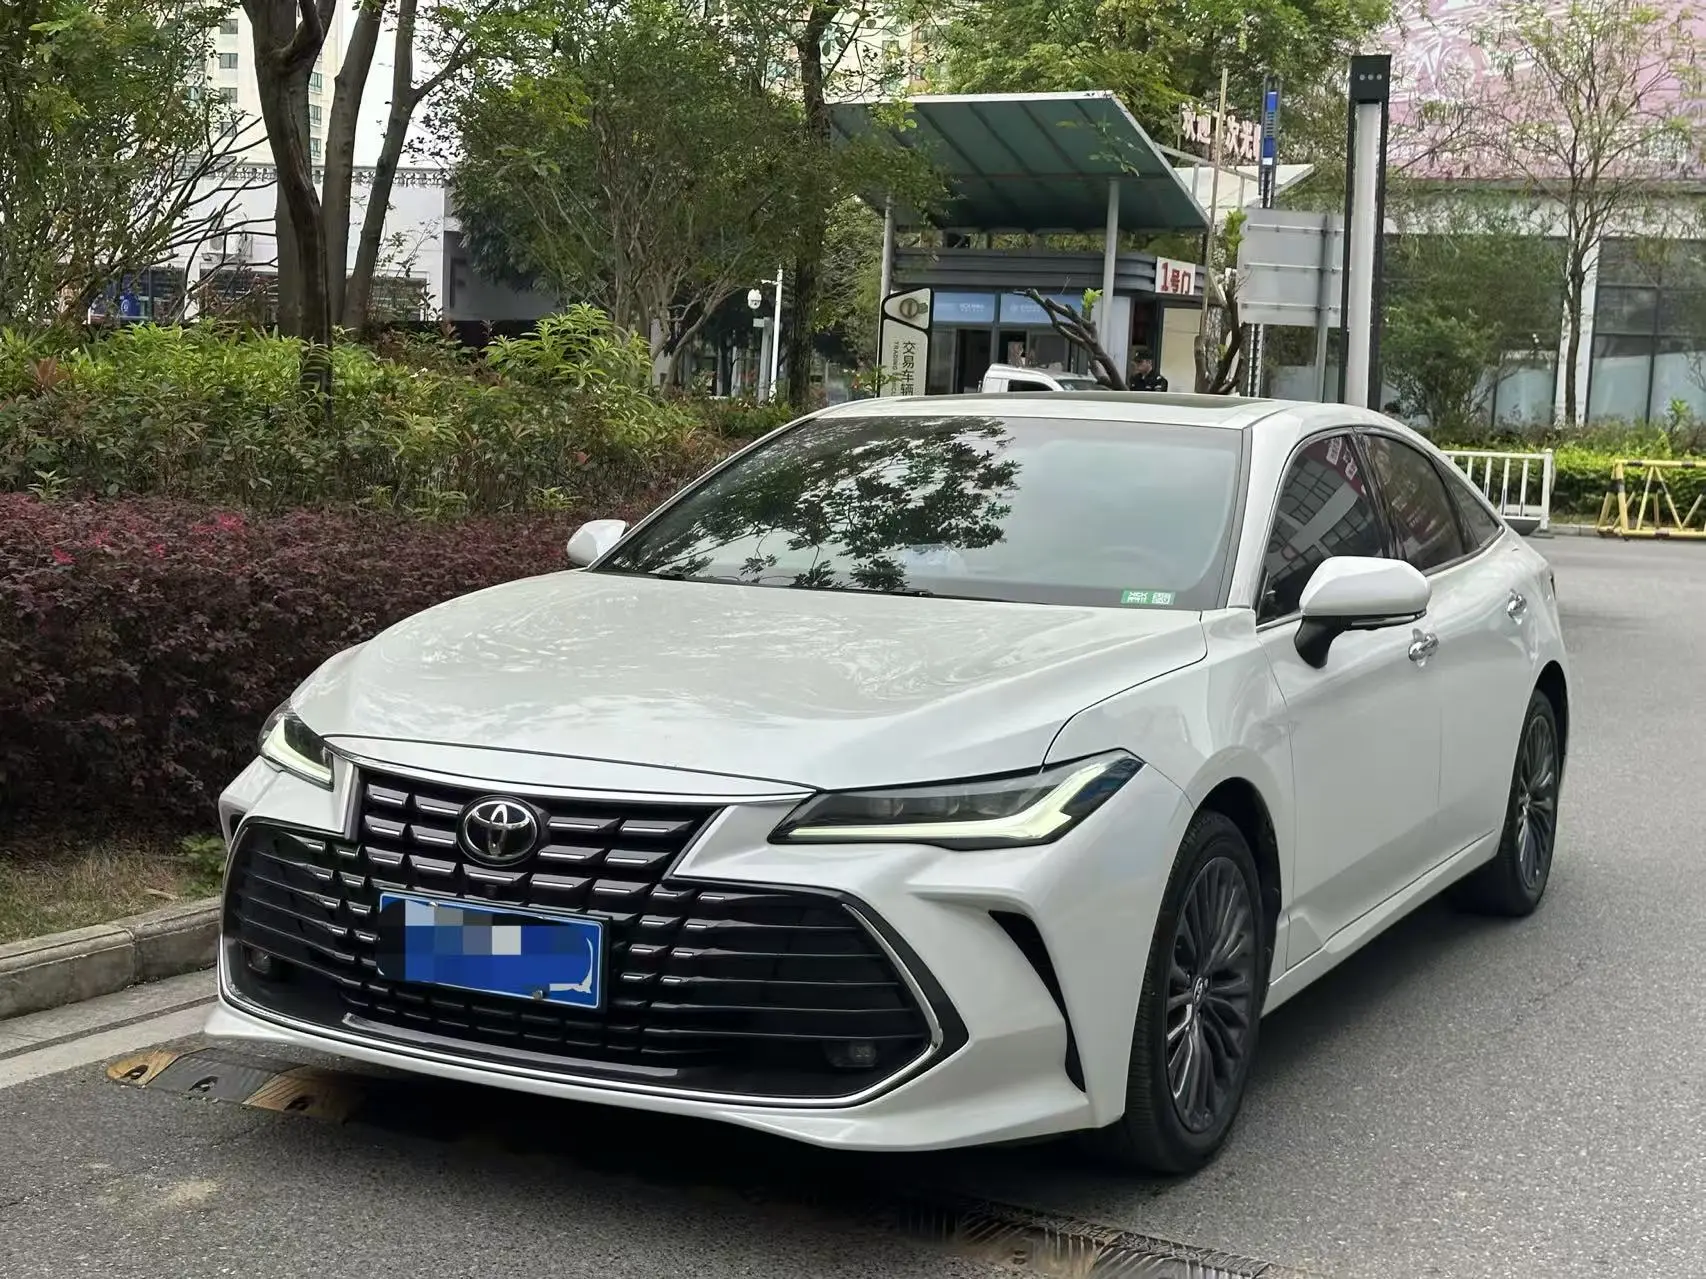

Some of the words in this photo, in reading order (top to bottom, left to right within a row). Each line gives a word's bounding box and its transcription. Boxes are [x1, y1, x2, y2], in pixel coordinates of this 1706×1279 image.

[1160, 262, 1191, 294] 1号门
[900, 341, 916, 395] 交易车辆
